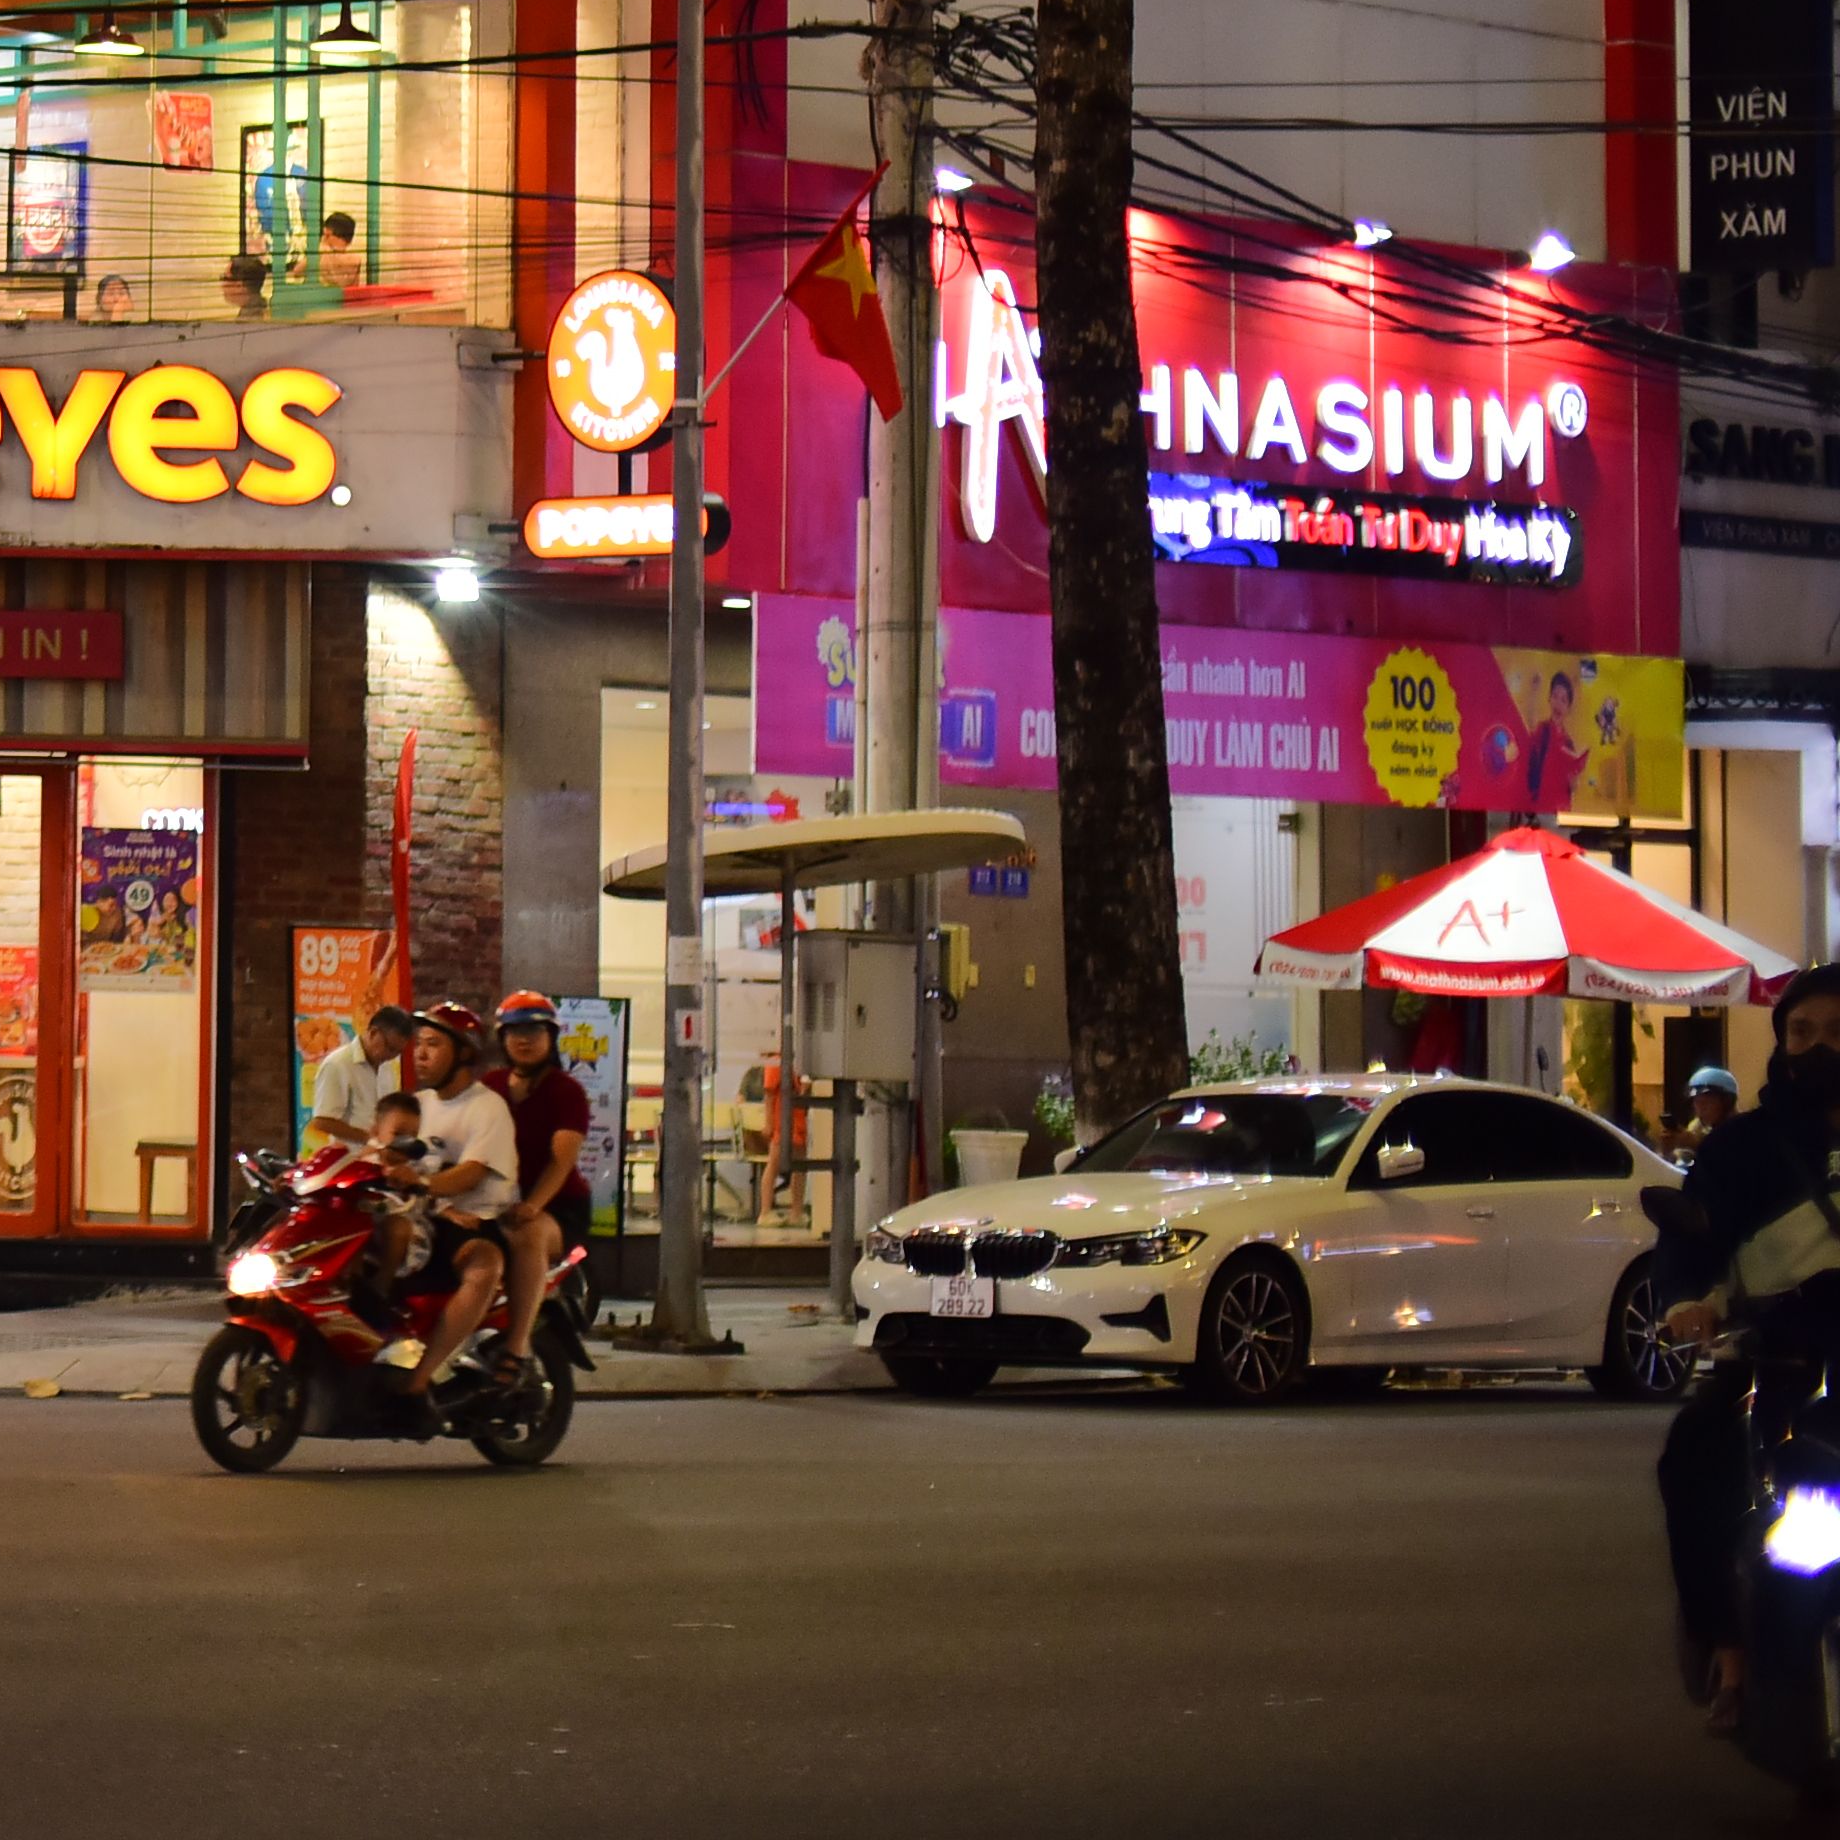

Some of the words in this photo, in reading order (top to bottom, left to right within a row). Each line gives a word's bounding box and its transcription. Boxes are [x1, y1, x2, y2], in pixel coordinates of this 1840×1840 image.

[1716, 85, 1789, 129] VIỆN
[1710, 149, 1796, 184] PHUN
[1719, 198, 1789, 239] XĂM
[1212, 486, 1282, 544] Tâm
[1282, 494, 1354, 548] Toán
[1400, 507, 1465, 568] Duy
[21, 623, 66, 663] IN
[79, 624, 90, 663] !
[1287, 661, 1306, 700] AI
[1390, 675, 1436, 712] 100
[960, 703, 983, 749] AI
[1213, 713, 1265, 770] LÀM
[1270, 714, 1313, 772] CHỦ
[1317, 724, 1340, 774] AI
[128, 888, 151, 904] 49
[1437, 898, 1526, 949] A+
[299, 934, 340, 977] 89
